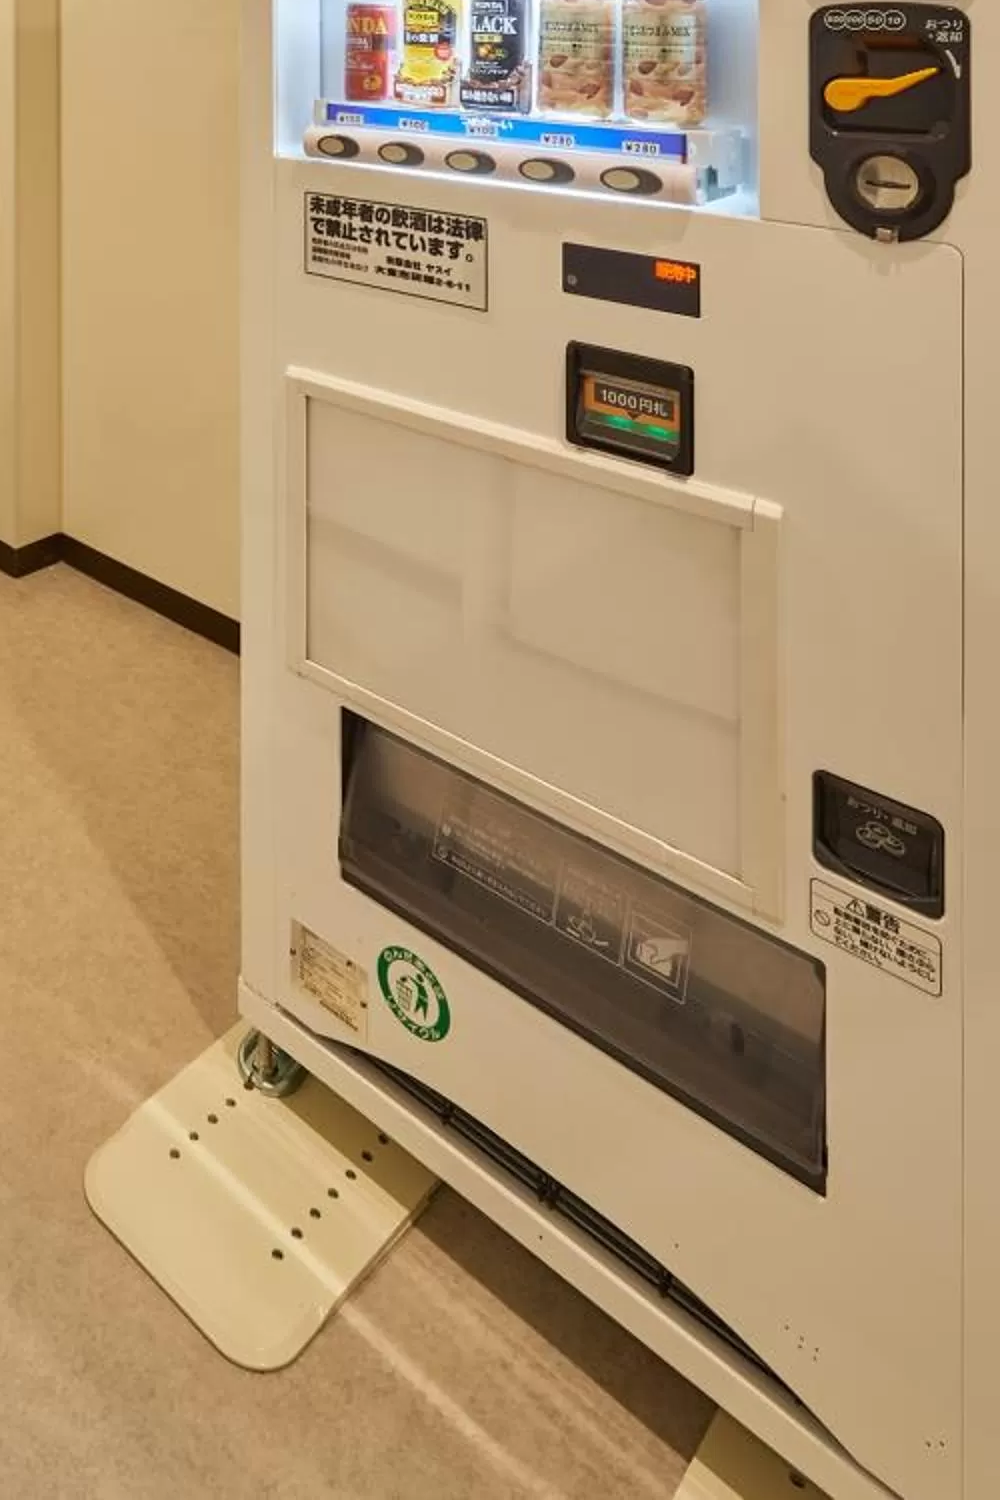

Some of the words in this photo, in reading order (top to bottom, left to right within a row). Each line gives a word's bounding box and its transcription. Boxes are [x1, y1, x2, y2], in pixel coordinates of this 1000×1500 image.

[347, 17, 387, 36] NDA
[471, 16, 517, 35] LACK
[887, 16, 901, 25] 10
[925, 19, 963, 31] おつり
[625, 142, 657, 155] ¥280
[309, 196, 484, 242] 未成年者の飲酒は法律
[309, 216, 474, 263] で禁止されています。
[601, 388, 669, 417] 1000円札
